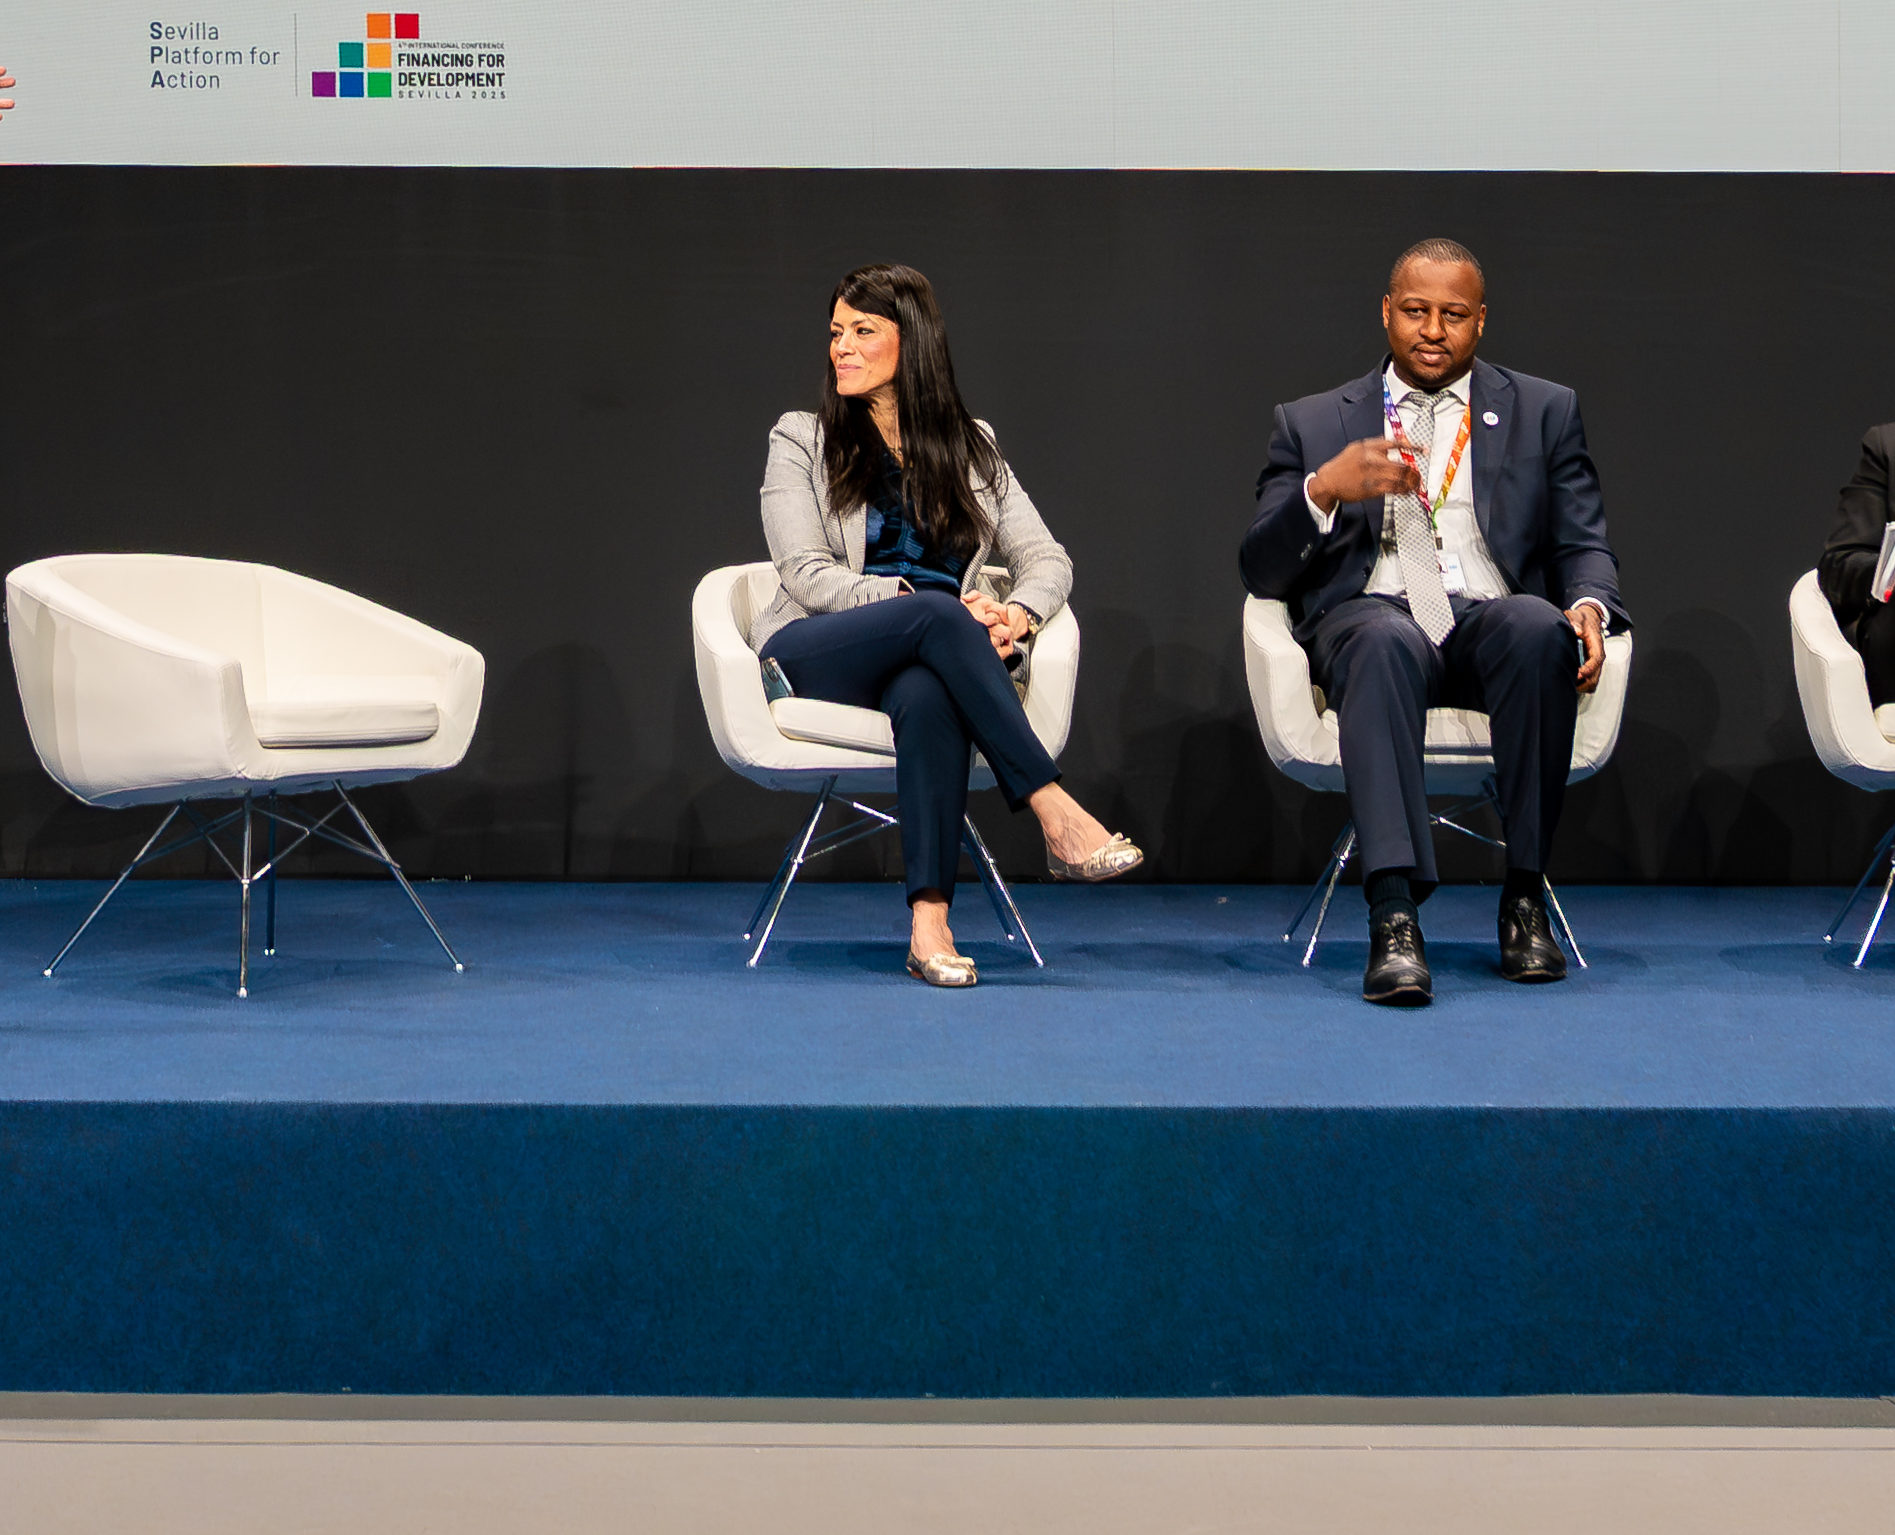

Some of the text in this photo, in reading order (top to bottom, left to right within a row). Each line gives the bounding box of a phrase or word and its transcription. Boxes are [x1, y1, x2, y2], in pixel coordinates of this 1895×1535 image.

[149, 21, 219, 41] Sevilla
[150, 45, 281, 66] Platform for
[398, 53, 505, 67] FINANCING FOR
[150, 69, 220, 89] Action
[398, 71, 506, 88] DEVELOPMENT
[398, 89, 506, 100] SEVILLA 2025
